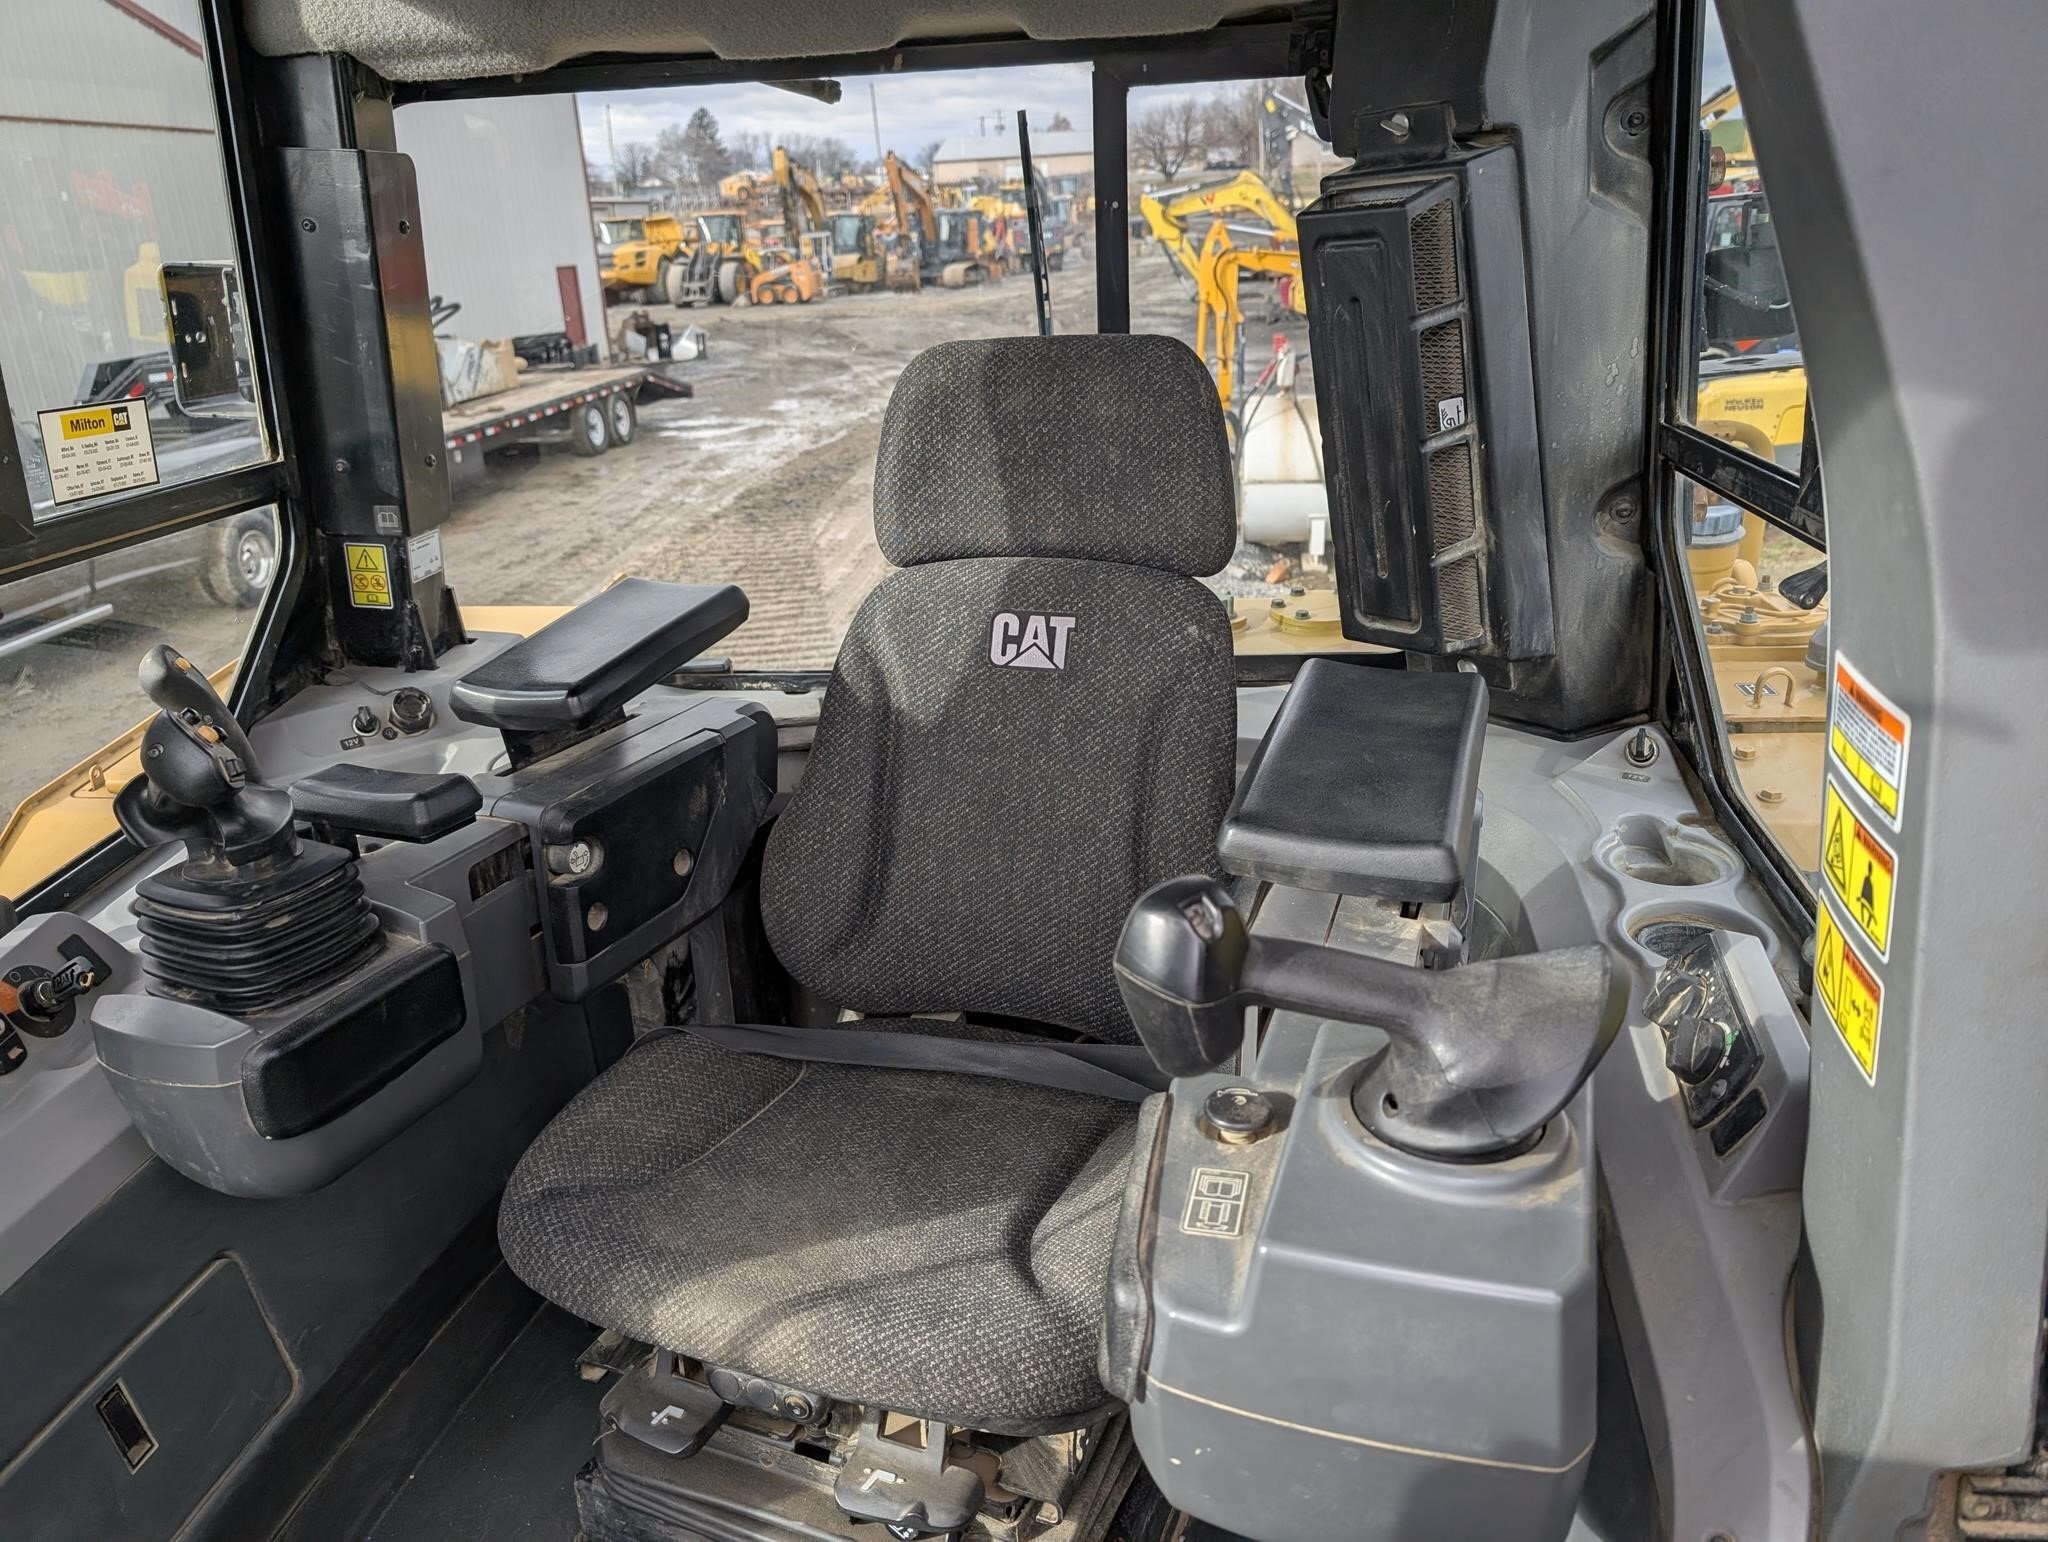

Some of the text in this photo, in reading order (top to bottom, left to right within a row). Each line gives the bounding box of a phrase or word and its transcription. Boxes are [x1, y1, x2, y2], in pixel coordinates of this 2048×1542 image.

[70, 412, 128, 433] Milton CAT
[990, 612, 1076, 670] CAT
[343, 736, 359, 747] 12V
[53, 968, 75, 991] CAT
